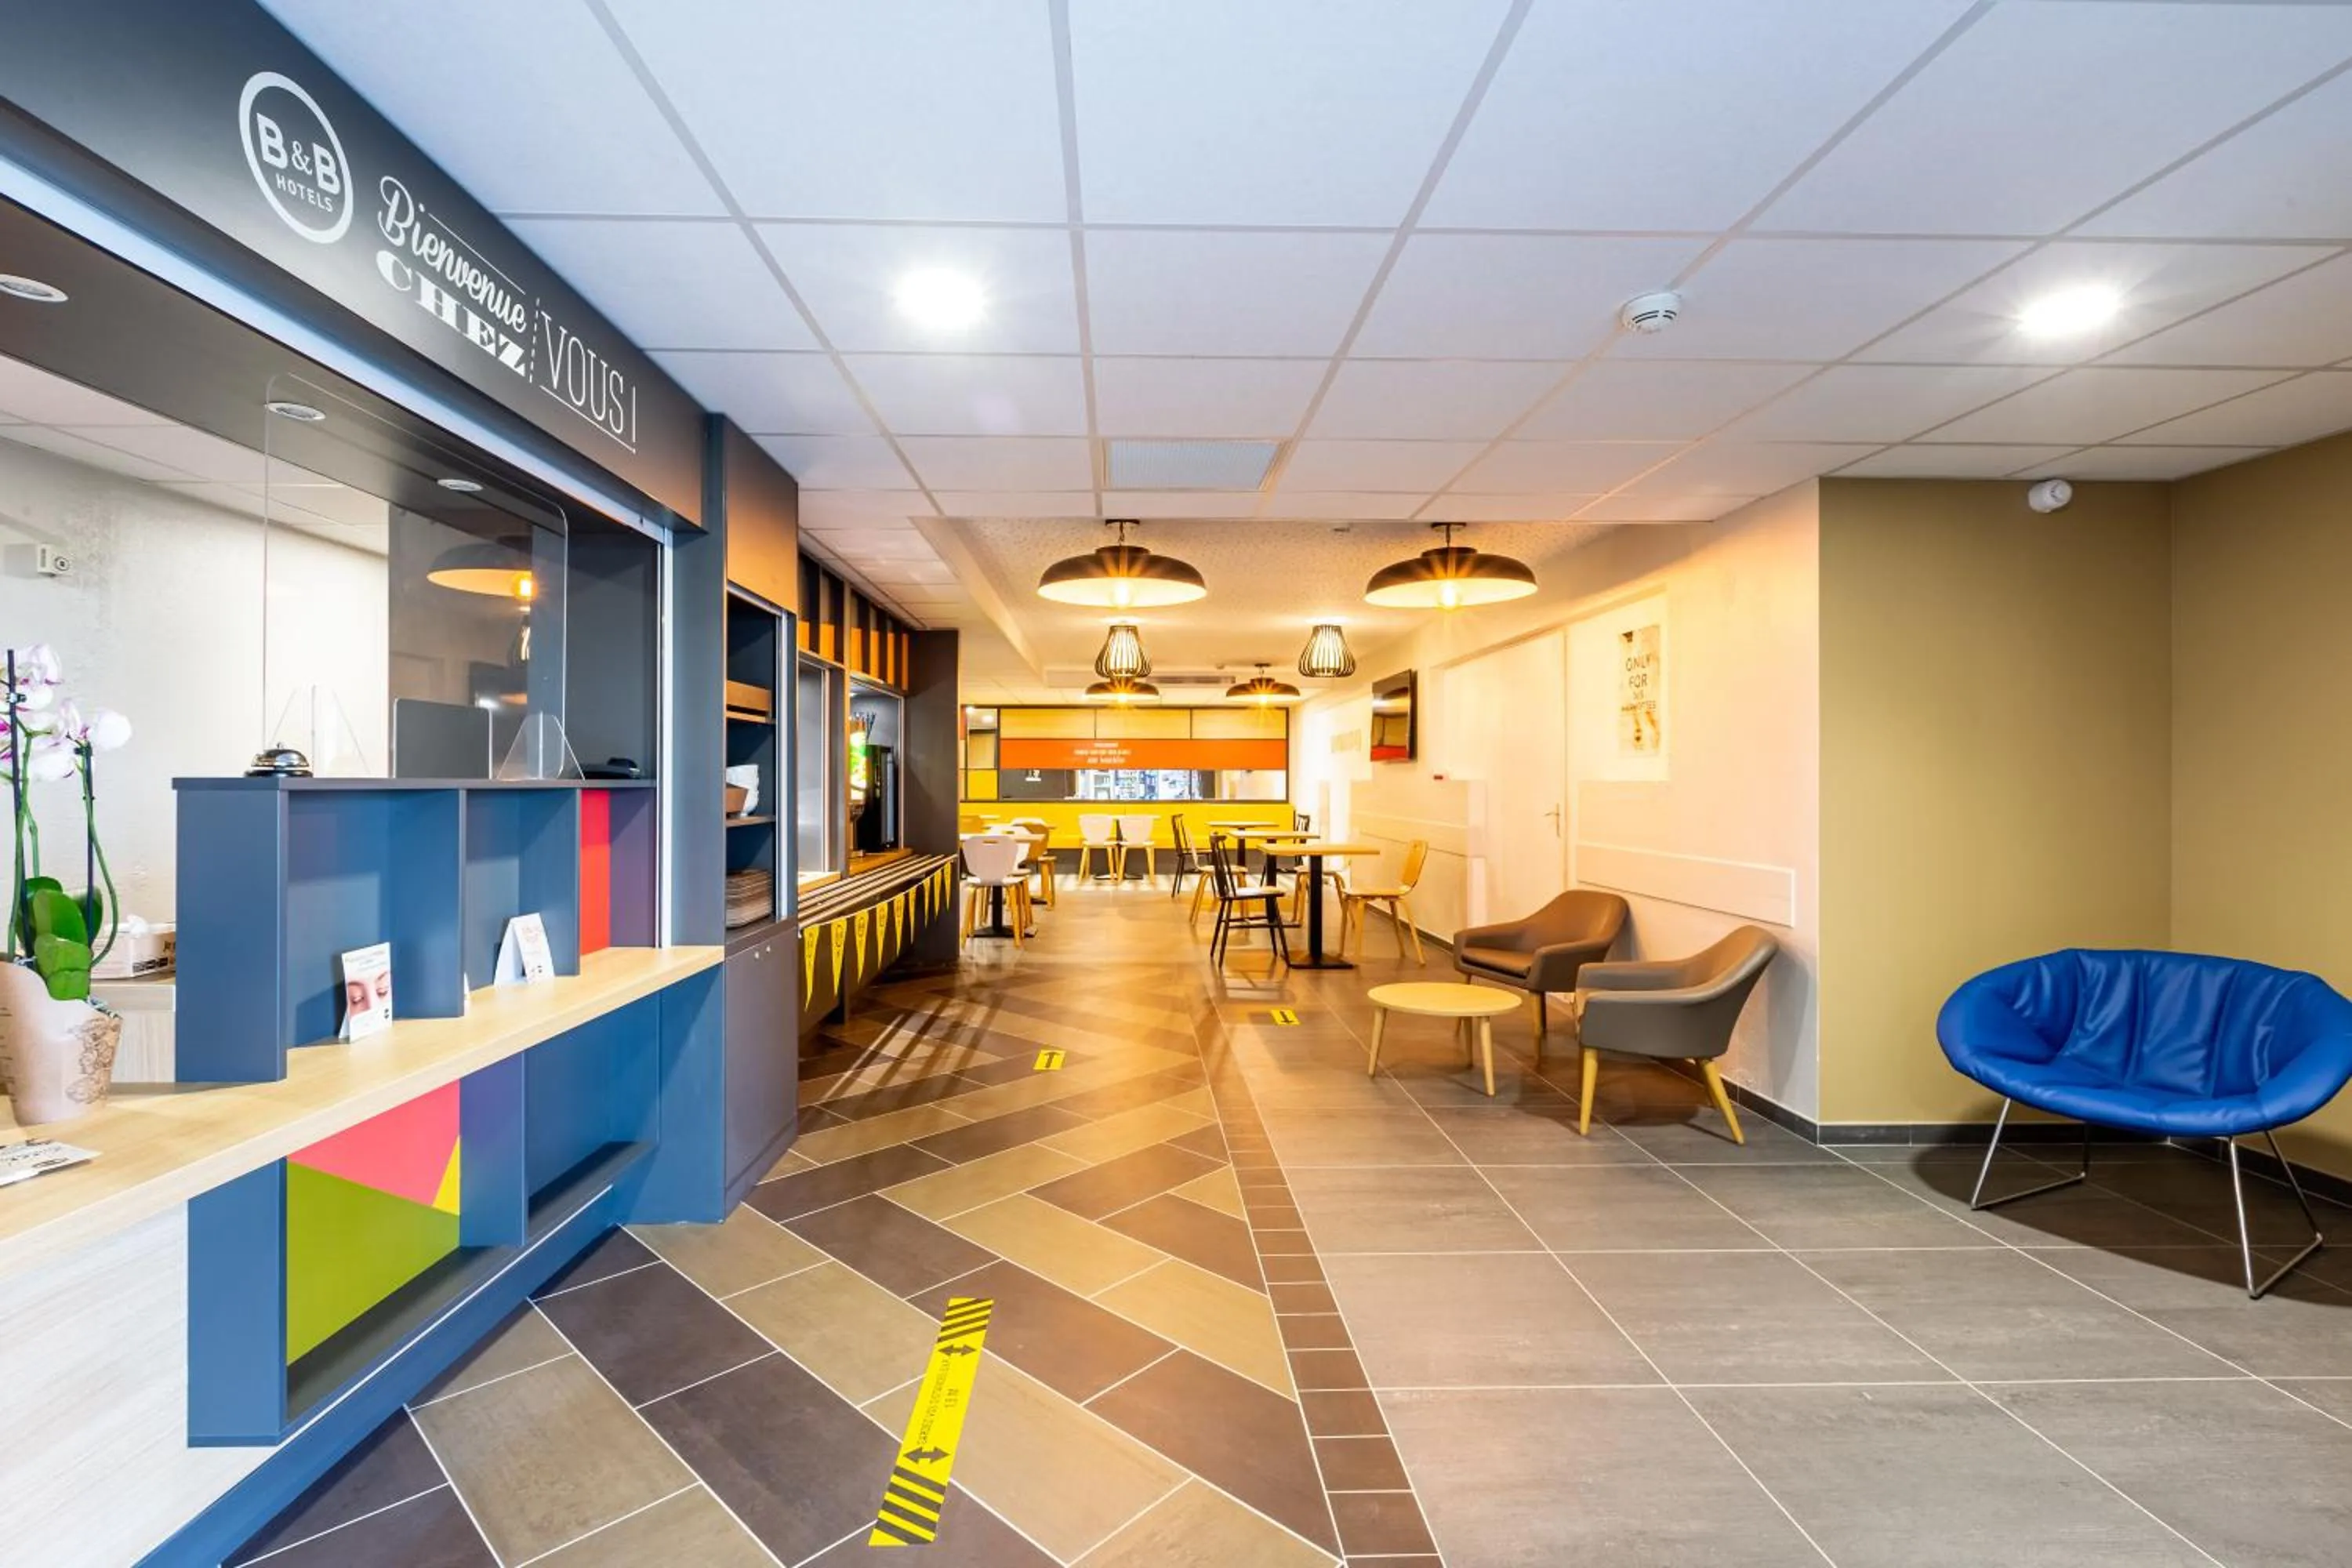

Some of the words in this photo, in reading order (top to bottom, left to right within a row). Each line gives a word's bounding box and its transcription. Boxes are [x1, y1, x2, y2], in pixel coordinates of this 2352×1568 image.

[256, 112, 341, 195] B&B
[275, 172, 333, 212] HOTELS
[377, 175, 527, 333] Bienvenue
[376, 249, 526, 377] CHEZ
[1629, 673, 1647, 688] FOR
